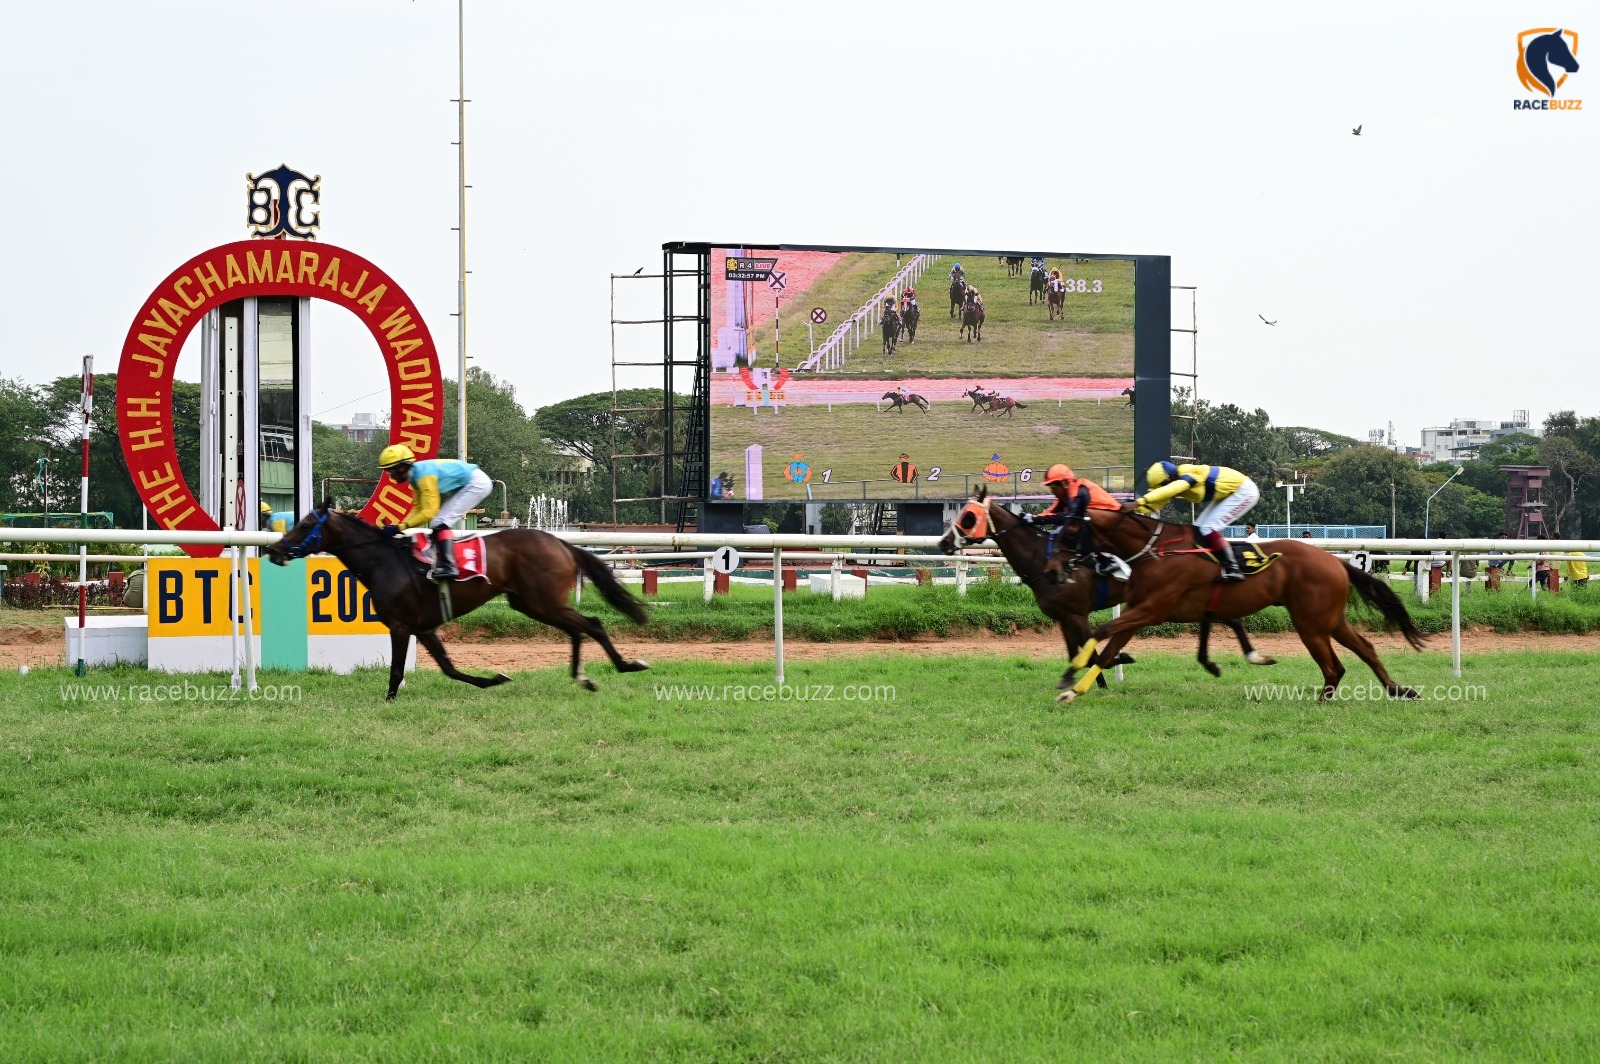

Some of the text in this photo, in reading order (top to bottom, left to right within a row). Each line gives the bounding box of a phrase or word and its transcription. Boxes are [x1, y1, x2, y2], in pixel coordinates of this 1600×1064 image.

[131, 249, 388, 379] JAYACHAMARAJA
[378, 305, 435, 455] WADIYAR
[126, 390, 165, 452] H.H.
[822, 468, 832, 483] 1
[927, 467, 941, 481] 2
[1020, 468, 1032, 482] 6
[138, 461, 196, 531] THE
[722, 549, 730, 570] 1
[1355, 553, 1367, 571] 3
